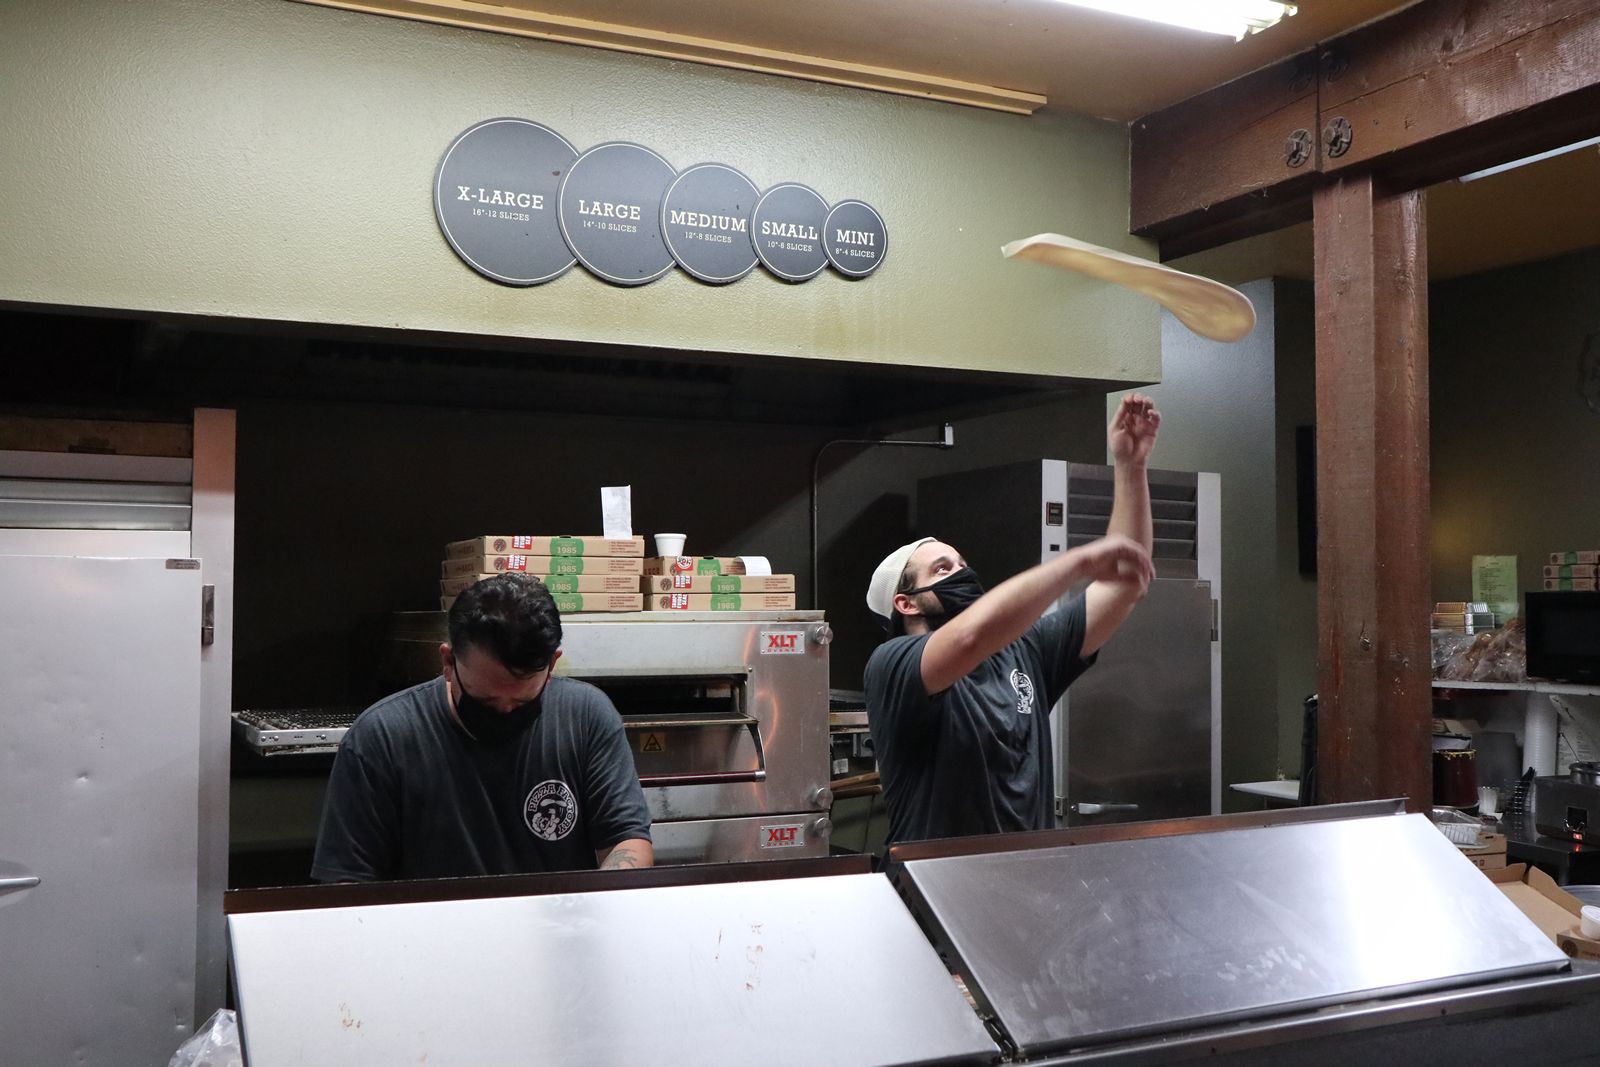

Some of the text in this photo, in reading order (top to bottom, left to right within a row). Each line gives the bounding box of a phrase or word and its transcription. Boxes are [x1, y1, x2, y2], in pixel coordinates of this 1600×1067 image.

[457, 185, 543, 209] X-LARGE
[499, 212, 530, 222] SLICES
[578, 199, 641, 221] LARGE
[608, 223, 637, 233] SLICES
[670, 210, 747, 233] MEDIUM
[704, 233, 732, 243] SLICES
[761, 221, 818, 241] SMALL
[836, 229, 875, 246] MINI
[786, 243, 813, 252] SLICES
[850, 249, 875, 258] SLICES
[552, 583, 572, 591] 1985
[768, 635, 797, 648] XLT
[528, 784, 556, 812] PIZZA
[557, 785, 575, 834] FACTORY
[768, 827, 798, 842] XLT
